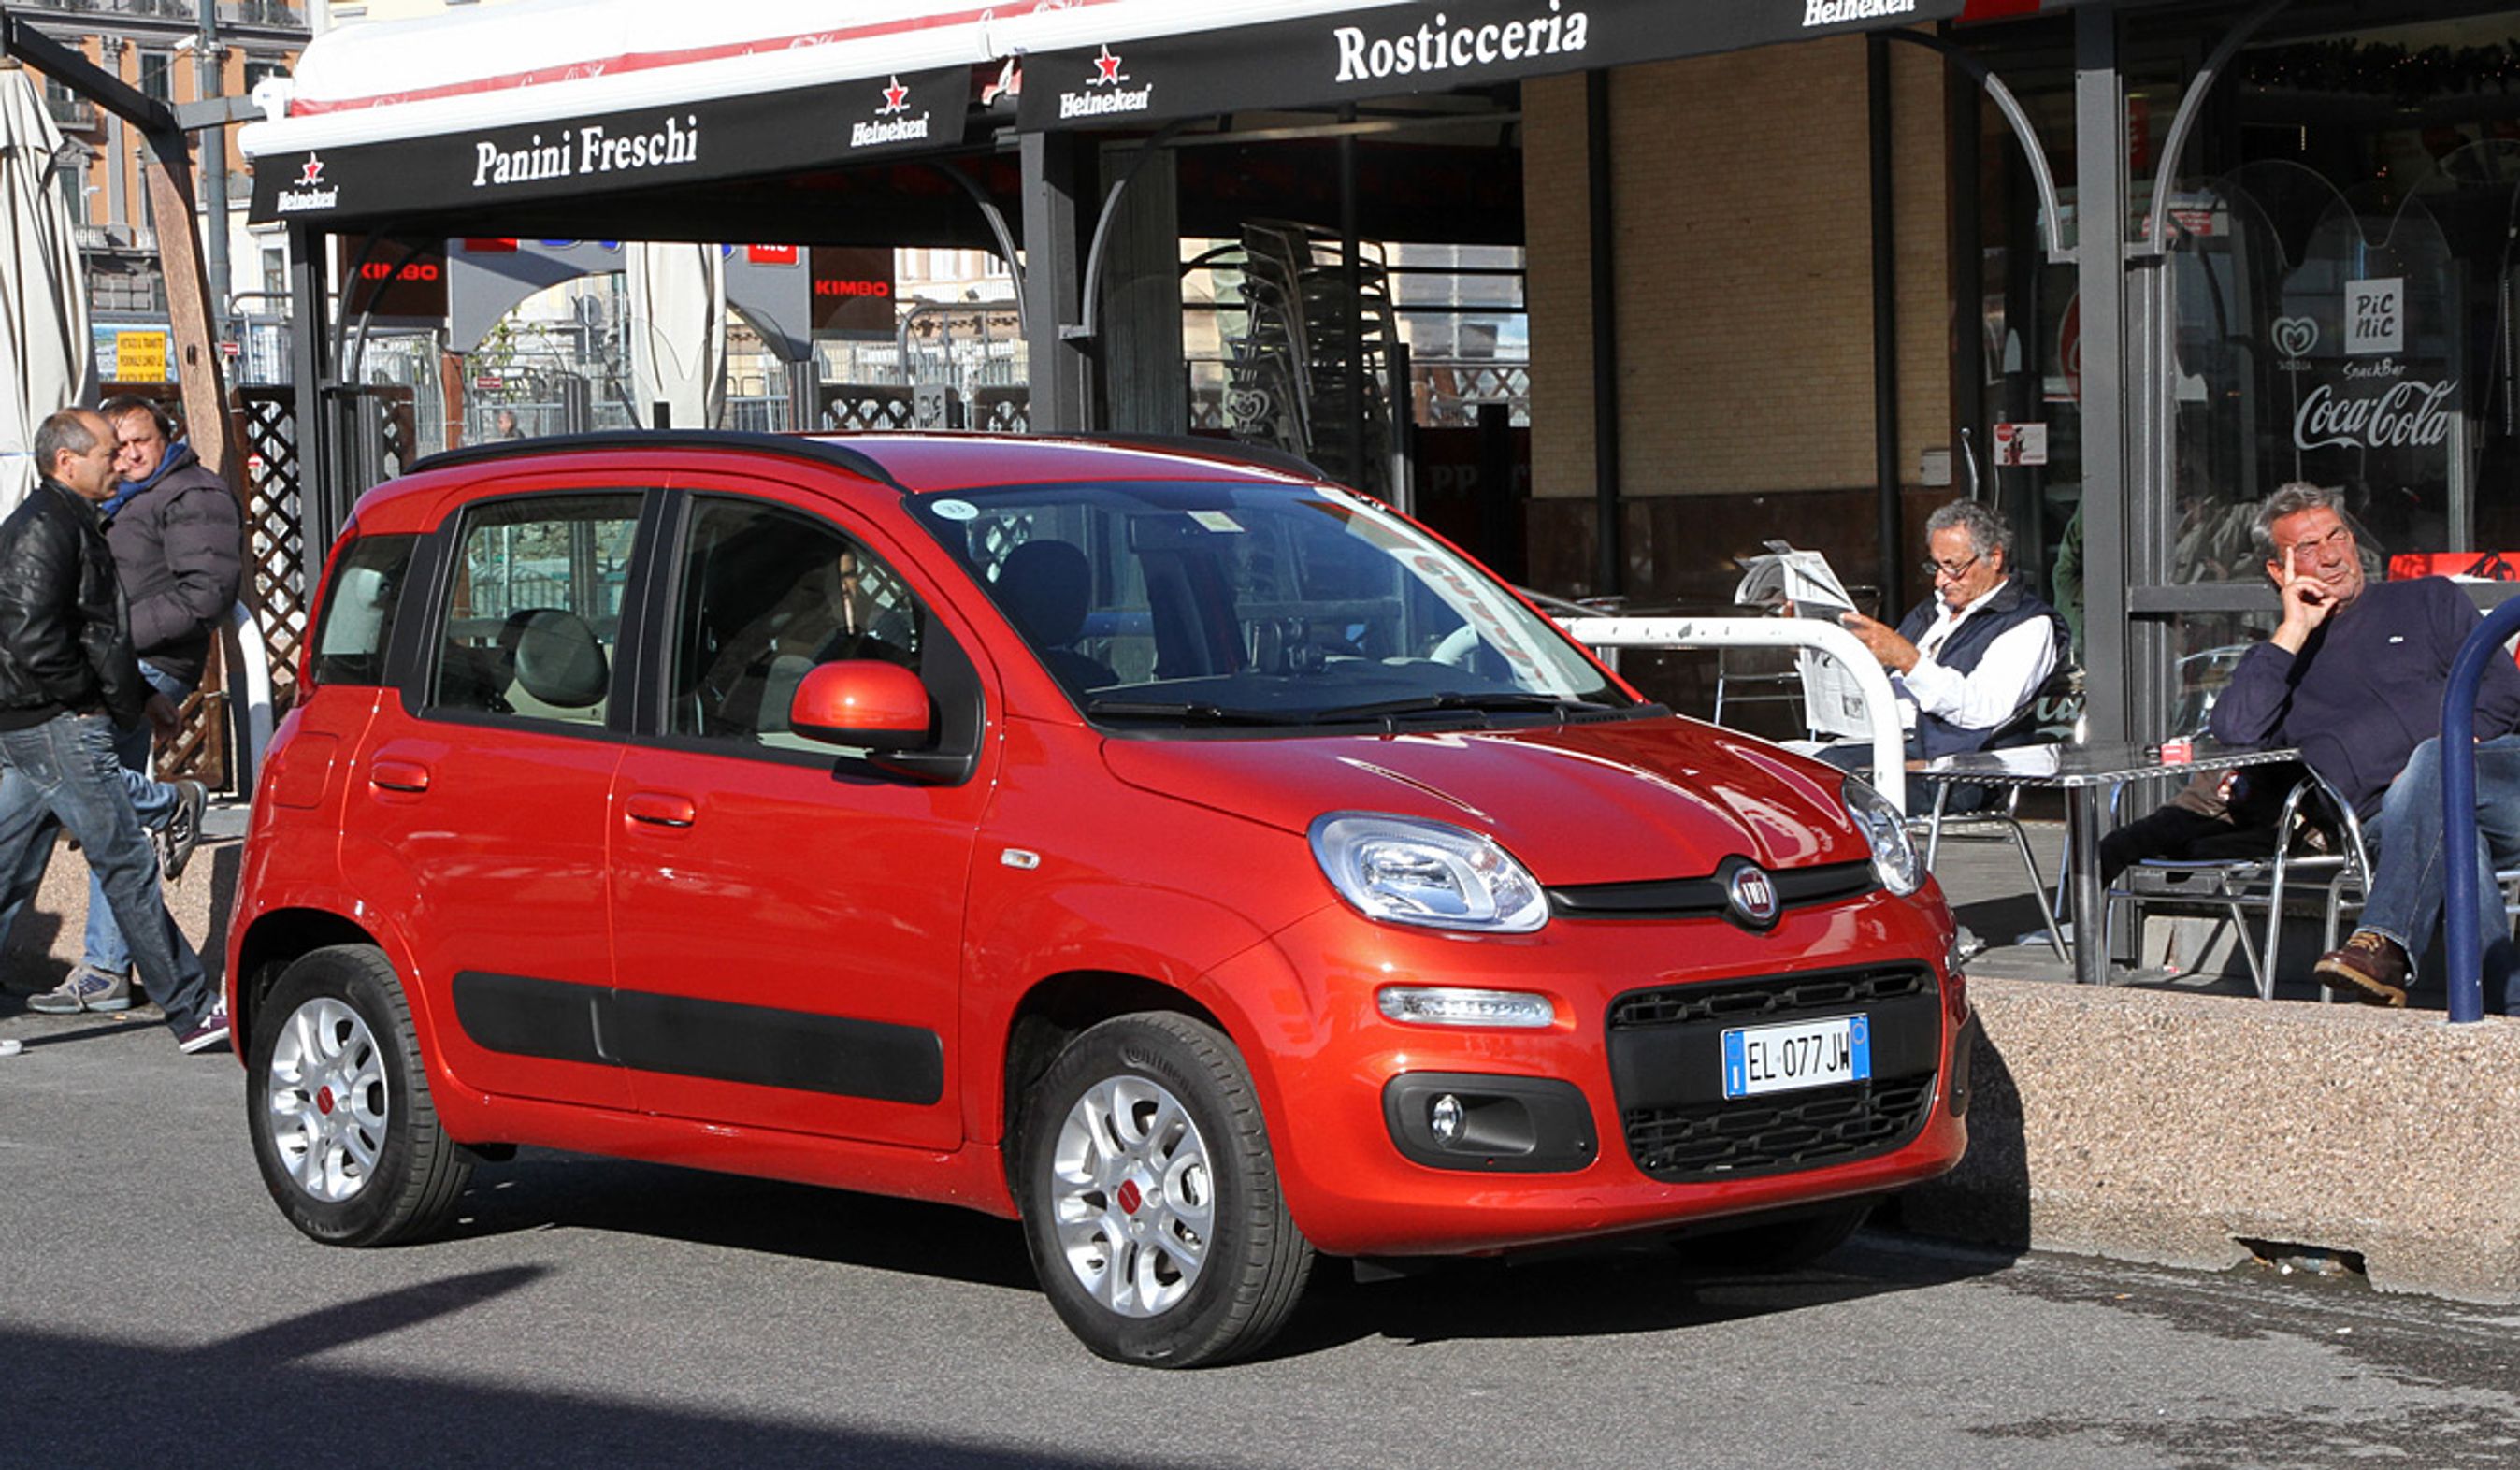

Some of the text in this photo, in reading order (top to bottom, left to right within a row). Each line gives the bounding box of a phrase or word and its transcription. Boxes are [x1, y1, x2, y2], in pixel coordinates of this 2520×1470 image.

[1333, 0, 1589, 82] Rosticceria
[1059, 83, 1153, 119] Heineken
[850, 111, 929, 147] Heineken
[472, 114, 698, 186] Panini Freschi
[277, 185, 339, 213] Heineken
[814, 280, 888, 296] KIMBO
[2294, 379, 2460, 450] Coca-Cola
[1748, 1041, 1776, 1081] EL
